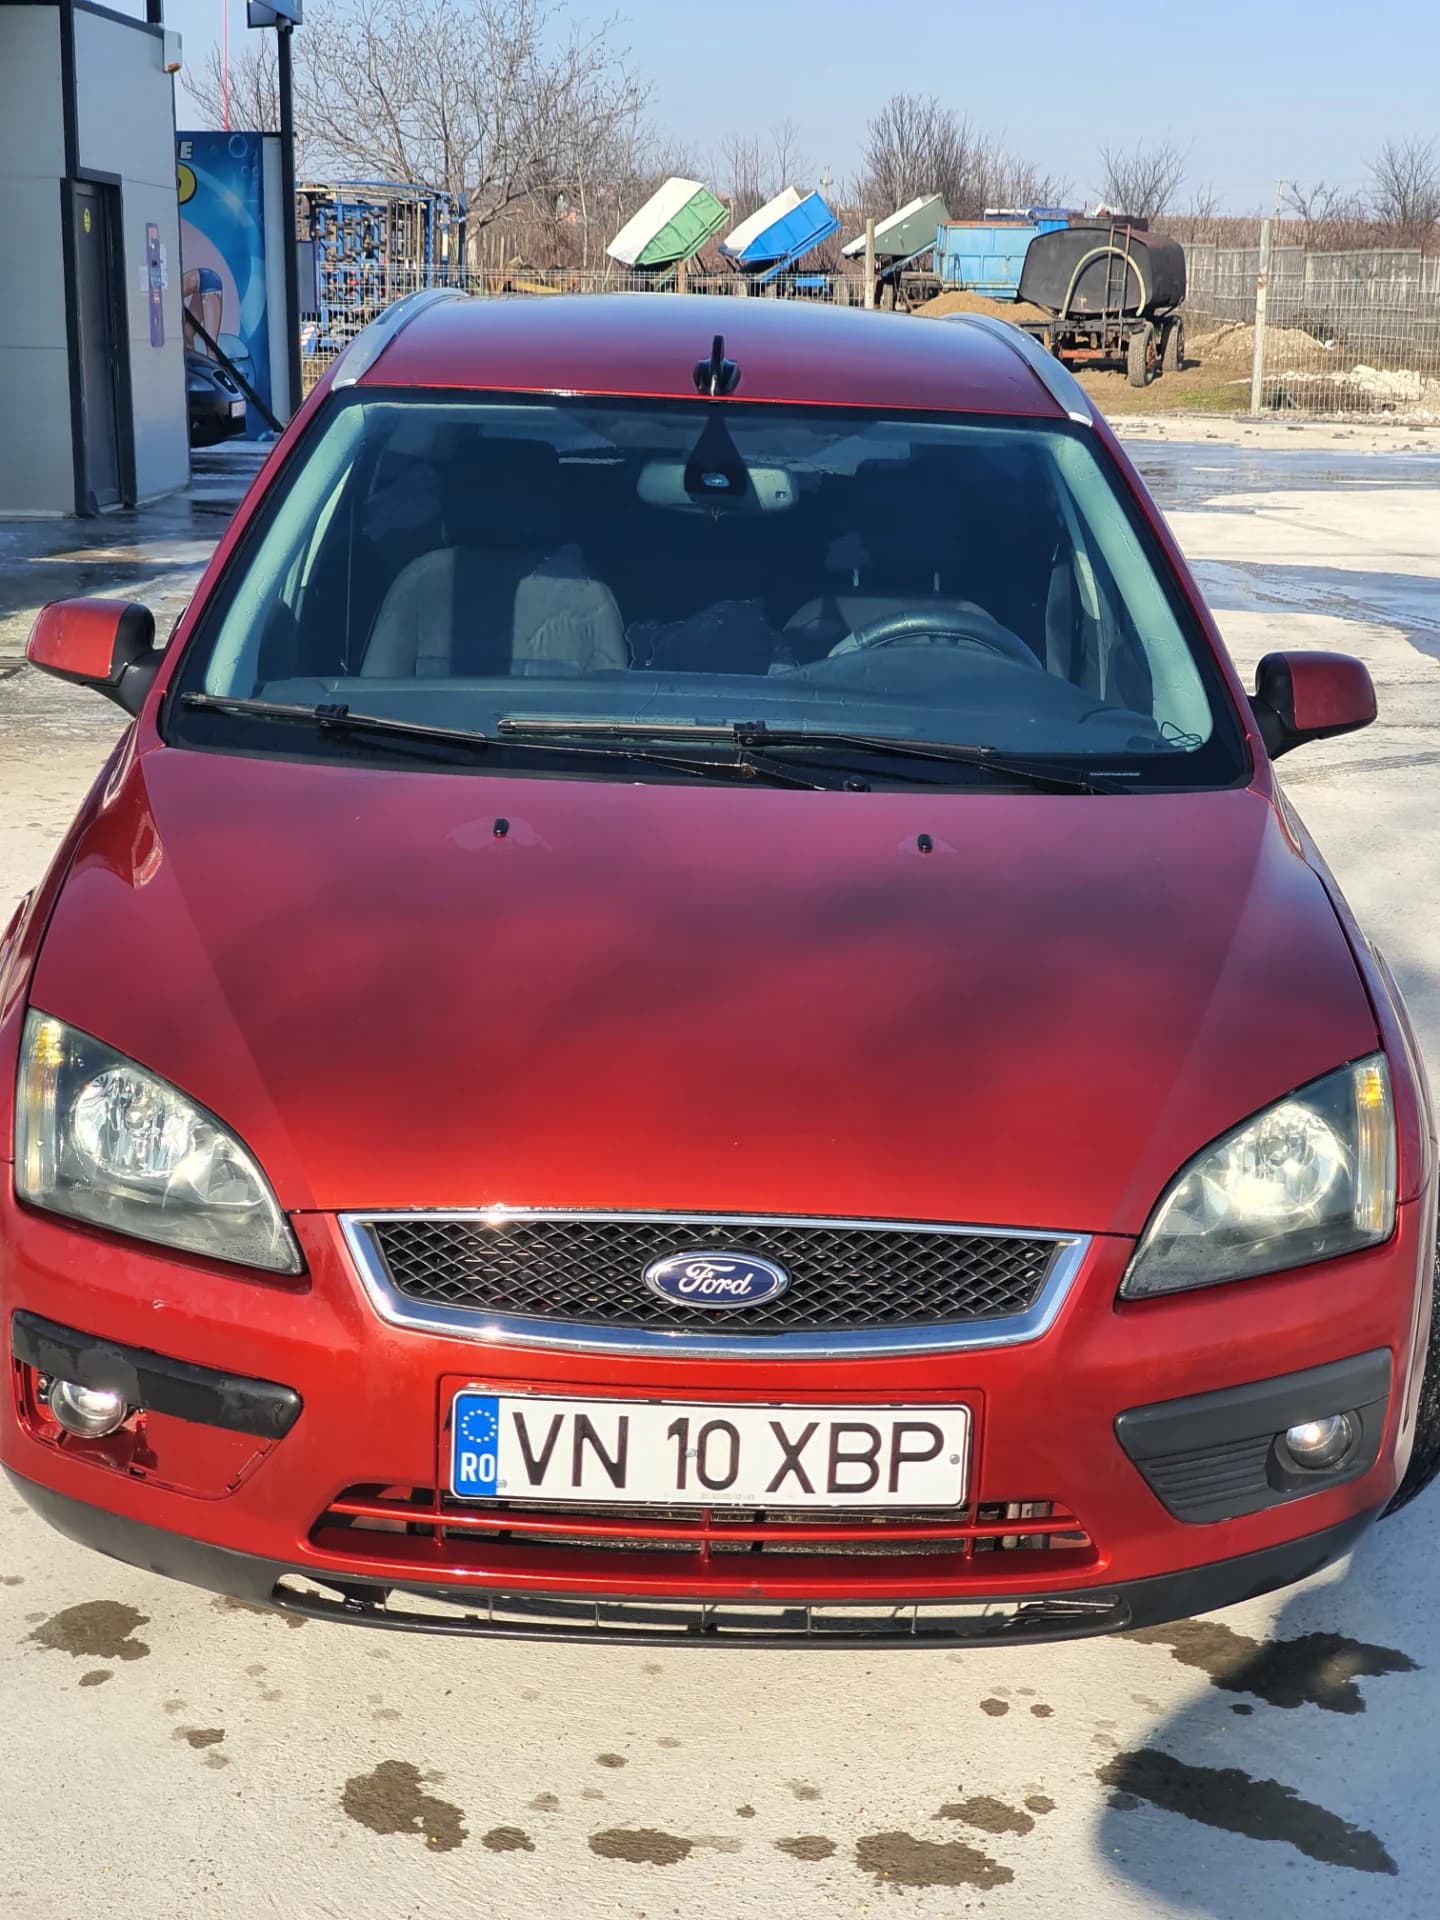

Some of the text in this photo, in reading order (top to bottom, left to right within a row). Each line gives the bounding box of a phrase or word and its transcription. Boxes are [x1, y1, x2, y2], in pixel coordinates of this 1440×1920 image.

[678, 1263, 754, 1295] Ford
[460, 1452, 496, 1482] RO
[512, 1412, 945, 1494] VN 10 XBP
